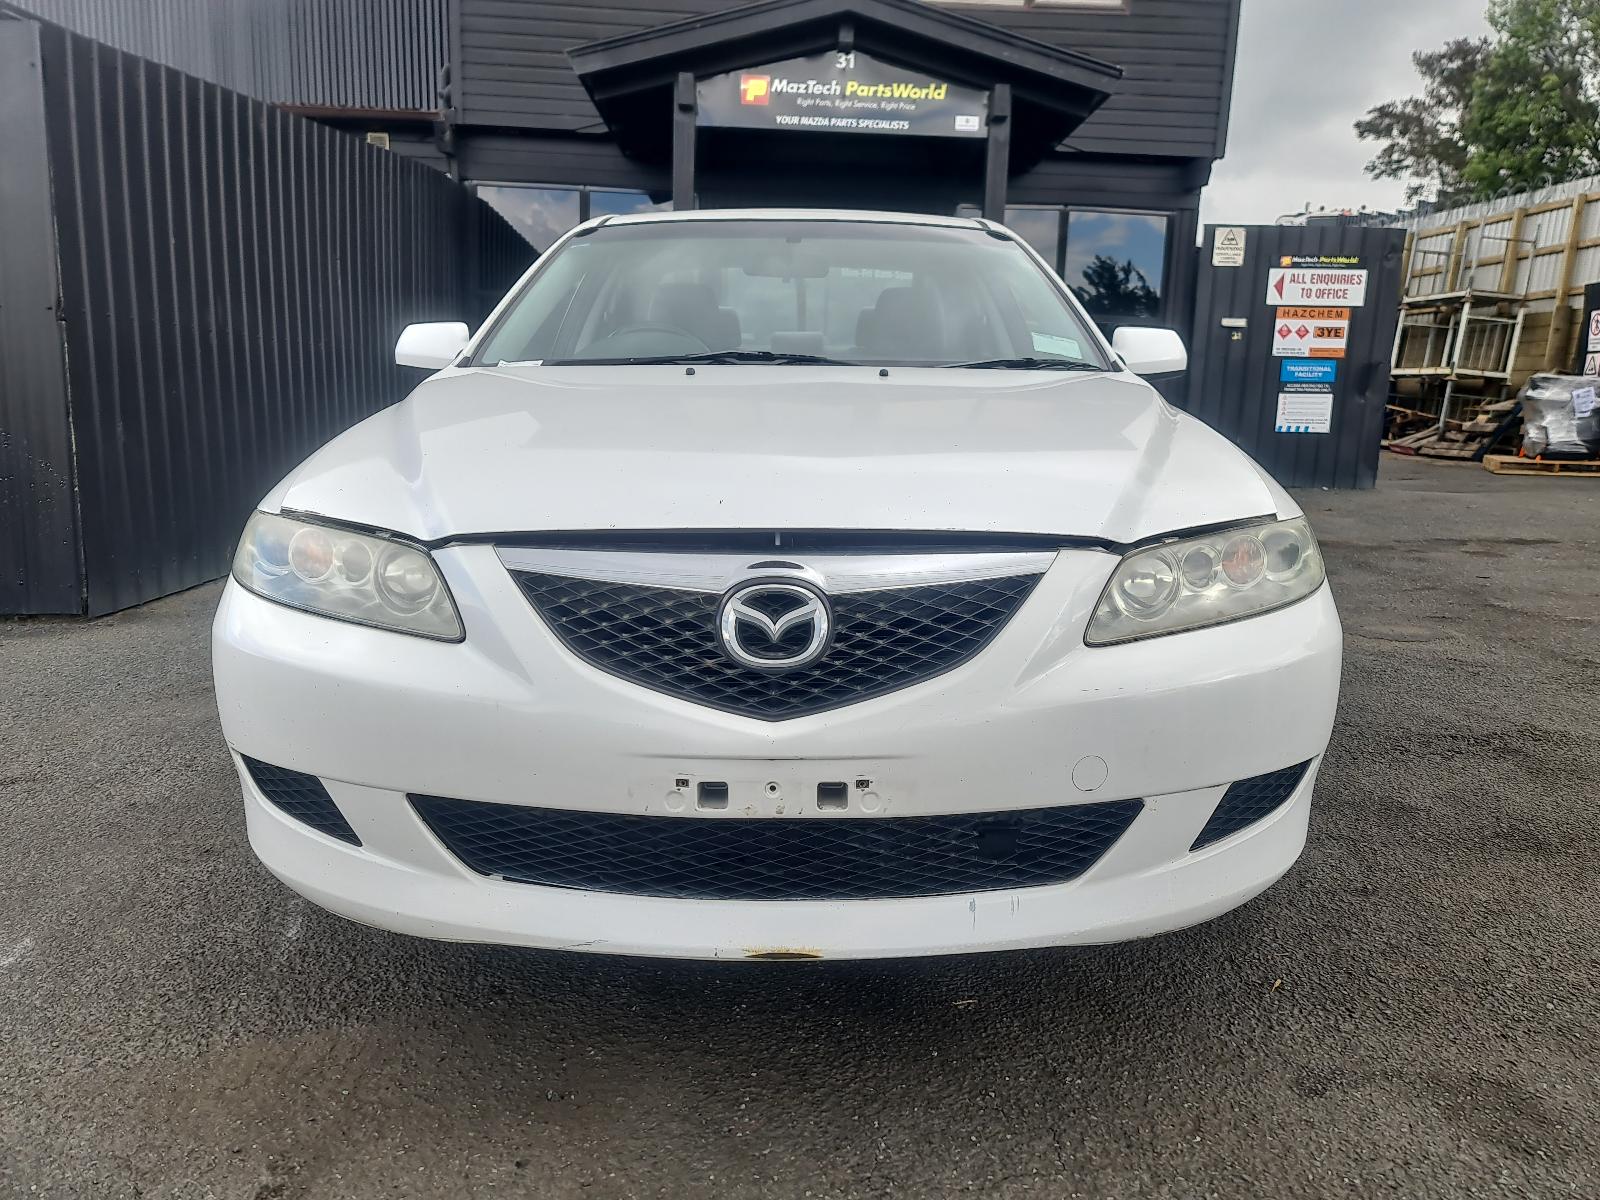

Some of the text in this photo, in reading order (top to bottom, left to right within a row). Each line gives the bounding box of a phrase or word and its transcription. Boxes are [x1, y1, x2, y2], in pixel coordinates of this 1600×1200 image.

[834, 52, 855, 69] 31
[771, 78, 948, 100] MazTech PartsWorld
[776, 115, 910, 130] YOUR MAZDA PARTS SPECIALISTS
[1289, 272, 1363, 286] ALL ENQUIRIES
[1300, 288, 1349, 300] TO OFFICE
[1282, 308, 1343, 318] HAZCHEM
[1316, 327, 1342, 338] 3YE
